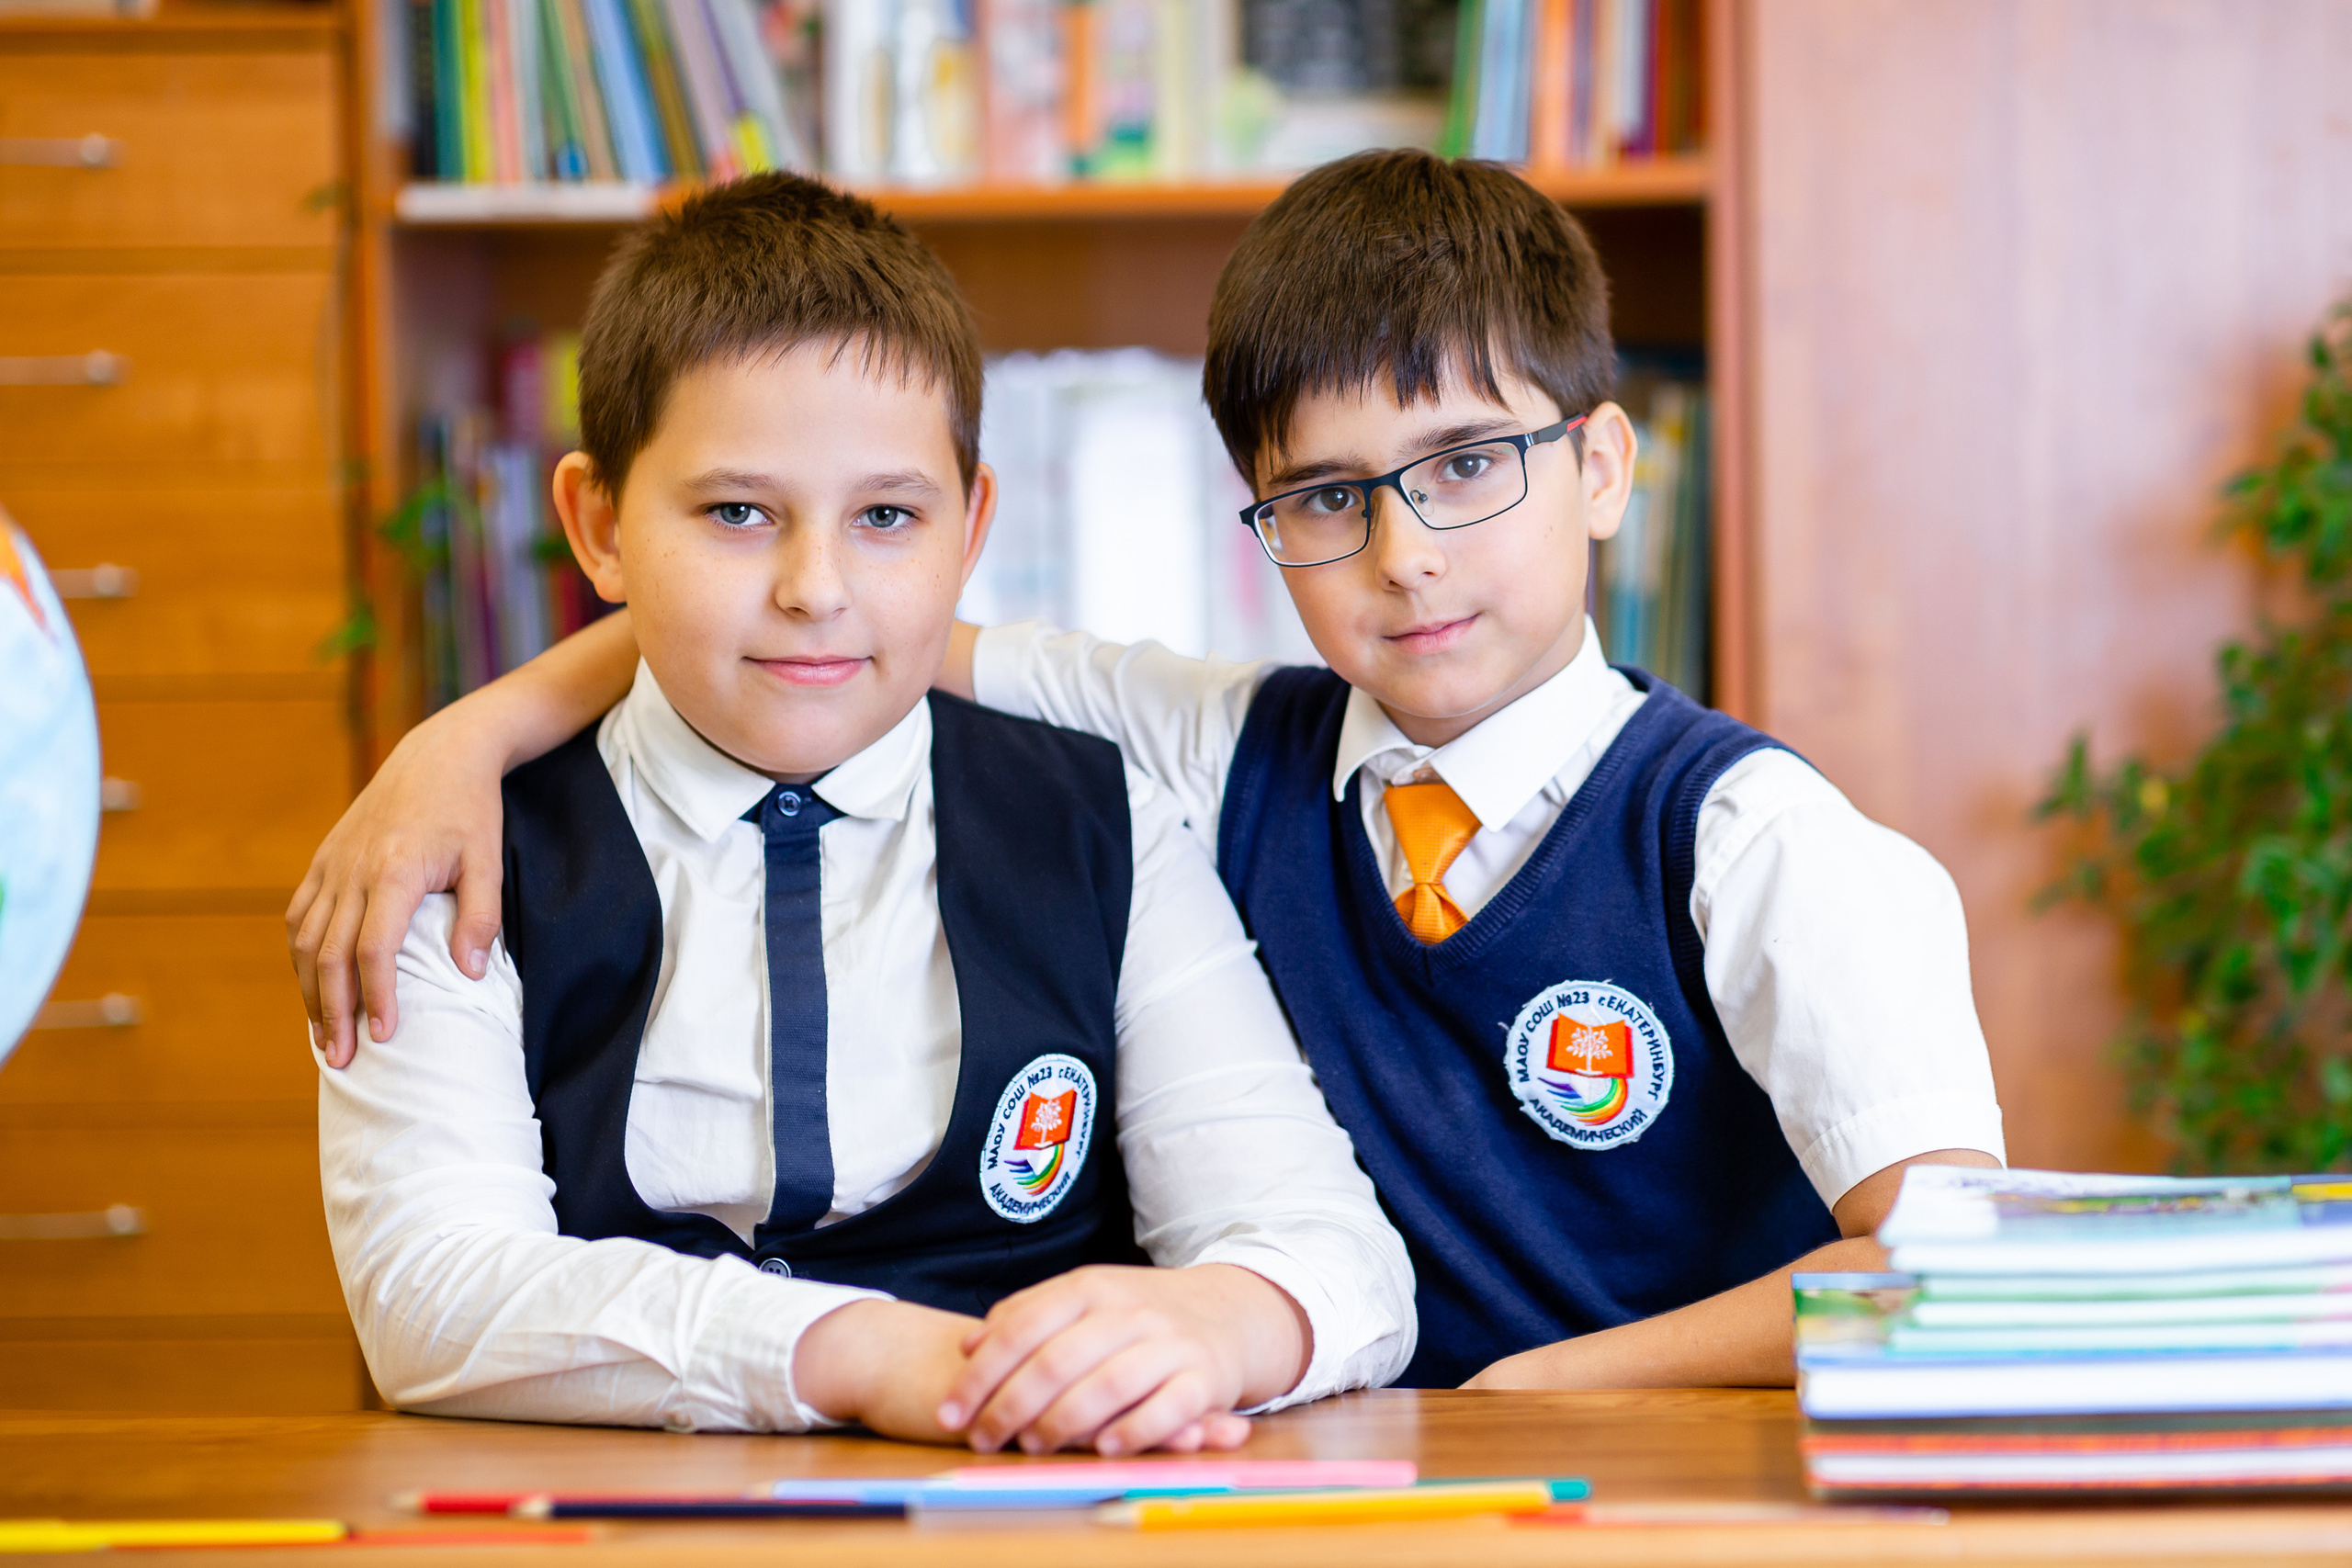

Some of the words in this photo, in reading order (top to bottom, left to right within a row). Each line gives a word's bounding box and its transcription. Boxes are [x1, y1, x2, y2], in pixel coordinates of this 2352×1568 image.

[1517, 1032, 1530, 1083] МАОУ
[1525, 999, 1555, 1033] СОШ
[1555, 991, 1589, 1009] №23
[987, 1122, 1006, 1170] МАОУ
[1002, 1084, 1026, 1120] СОШ
[1027, 1066, 1053, 1089] №23
[1529, 1099, 1648, 1143] АКАДЕМИЧЕСКИЙ
